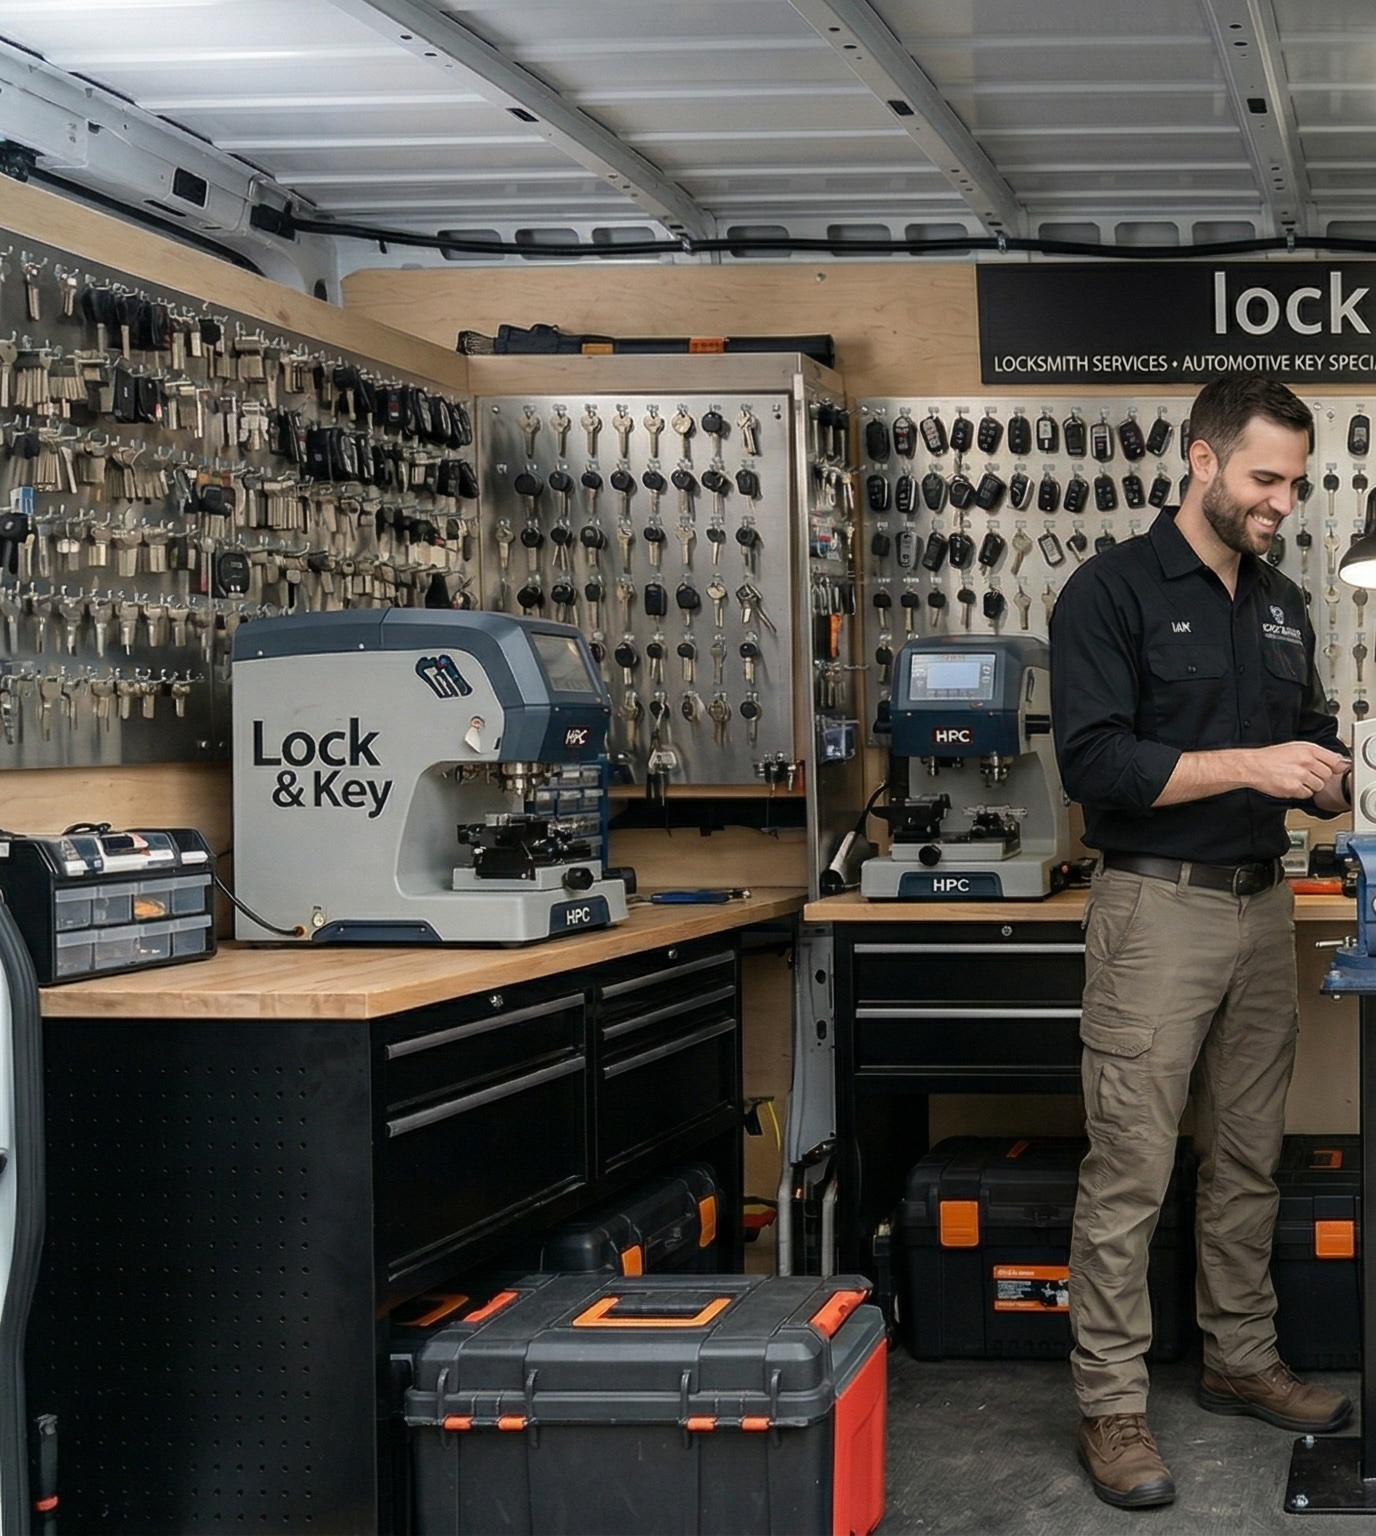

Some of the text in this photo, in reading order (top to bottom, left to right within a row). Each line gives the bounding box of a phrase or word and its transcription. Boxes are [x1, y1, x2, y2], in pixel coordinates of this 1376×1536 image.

[1214, 271, 1371, 335] lock
[994, 355, 1088, 372] LOCKSMITH
[1093, 355, 1168, 372] SERVICES
[1182, 354, 1290, 371] AUTOMOTIVE
[1295, 354, 1325, 371] KEY
[253, 717, 381, 767] Lock
[272, 769, 393, 819] & Key
[933, 878, 970, 892] HPC
[566, 906, 590, 926] HPC
